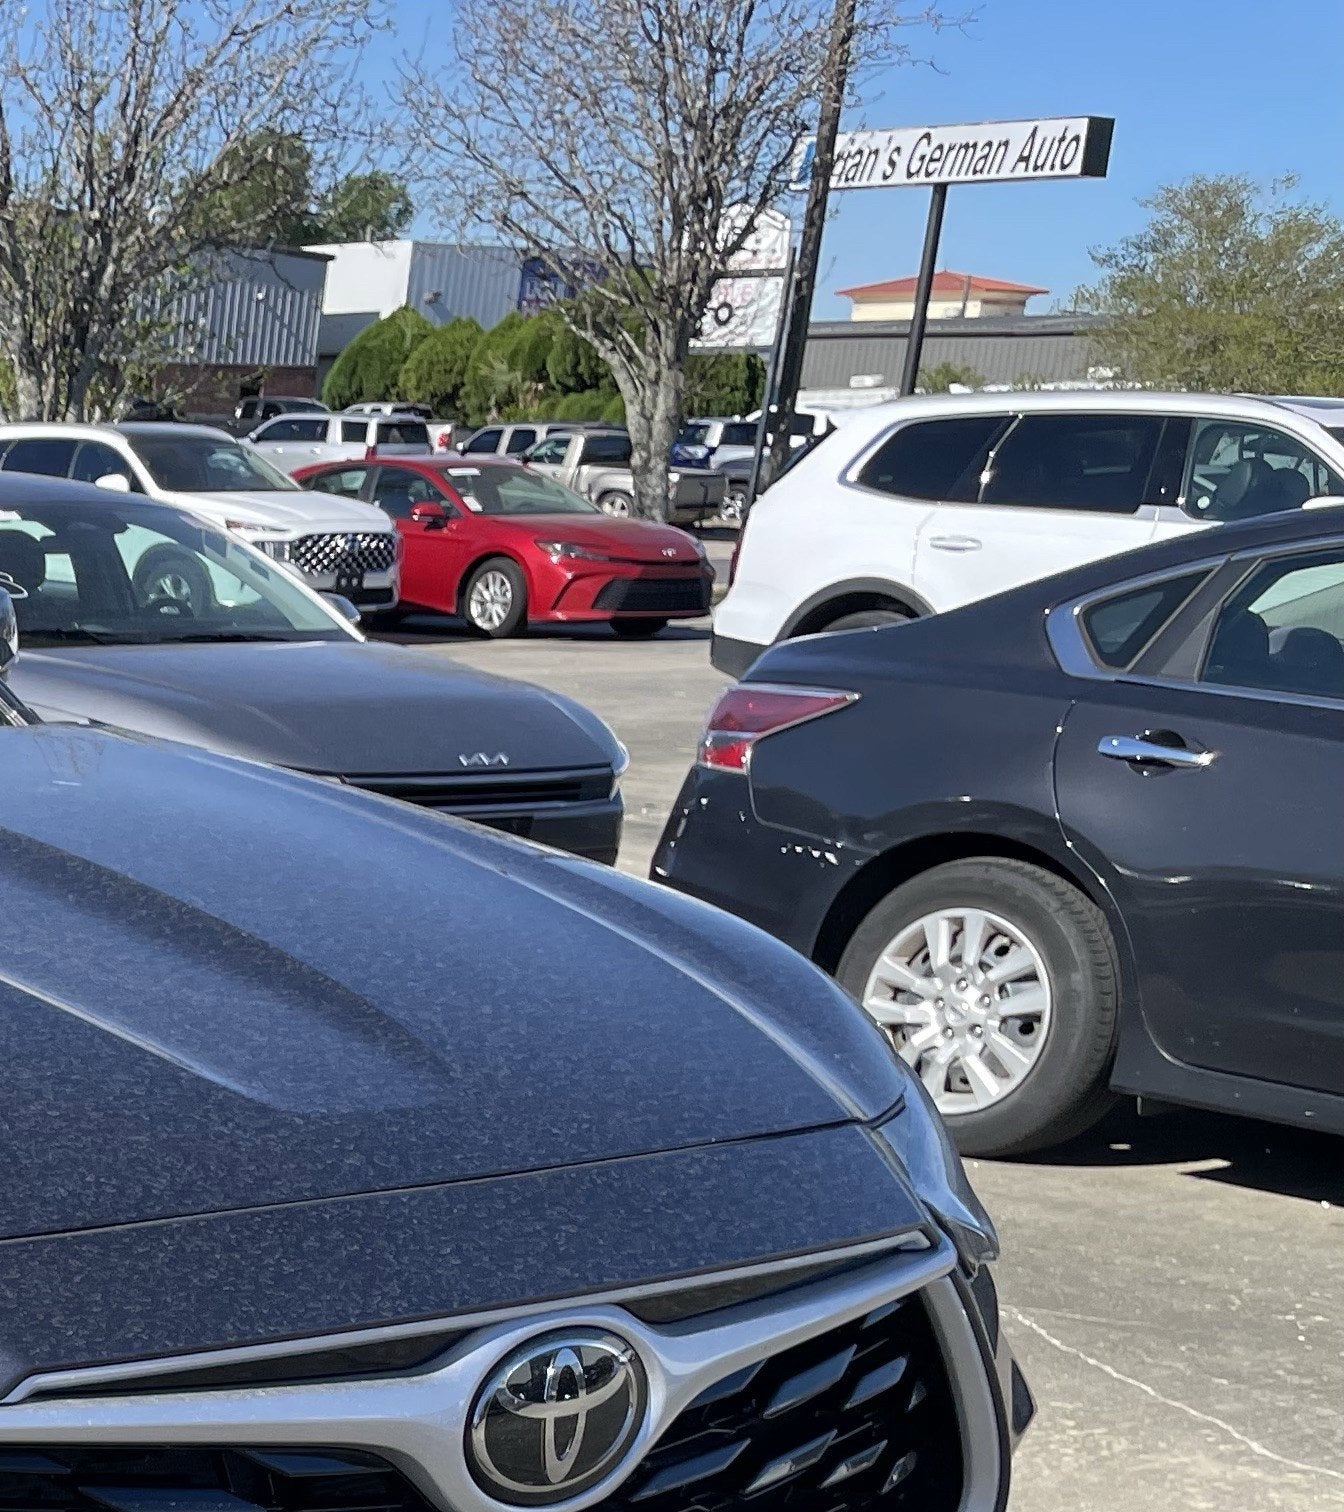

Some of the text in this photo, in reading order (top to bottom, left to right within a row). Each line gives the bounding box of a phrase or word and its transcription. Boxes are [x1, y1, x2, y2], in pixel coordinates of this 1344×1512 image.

[832, 125, 1082, 183] rian's German Auto
